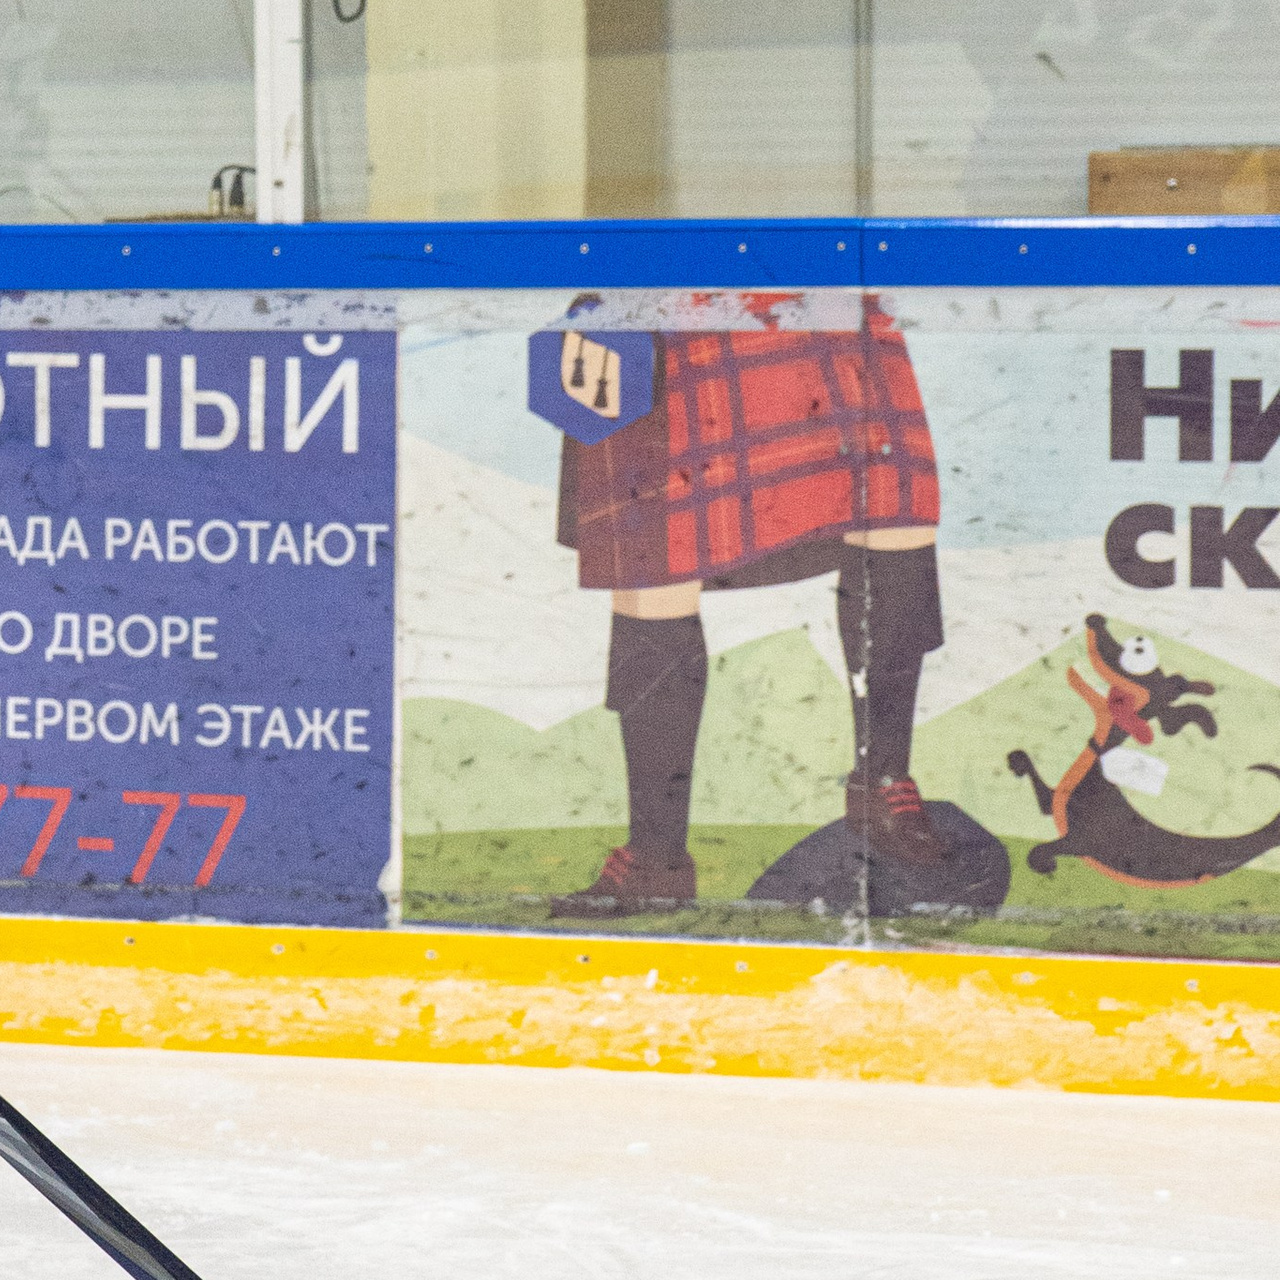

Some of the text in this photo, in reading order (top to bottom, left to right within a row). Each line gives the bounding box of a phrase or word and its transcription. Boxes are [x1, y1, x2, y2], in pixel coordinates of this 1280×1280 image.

[105, 518, 391, 567] РАБОТАЮТ
[45, 612, 219, 662] ДВОРЕ
[196, 703, 371, 753] ЭТАЖЕ
